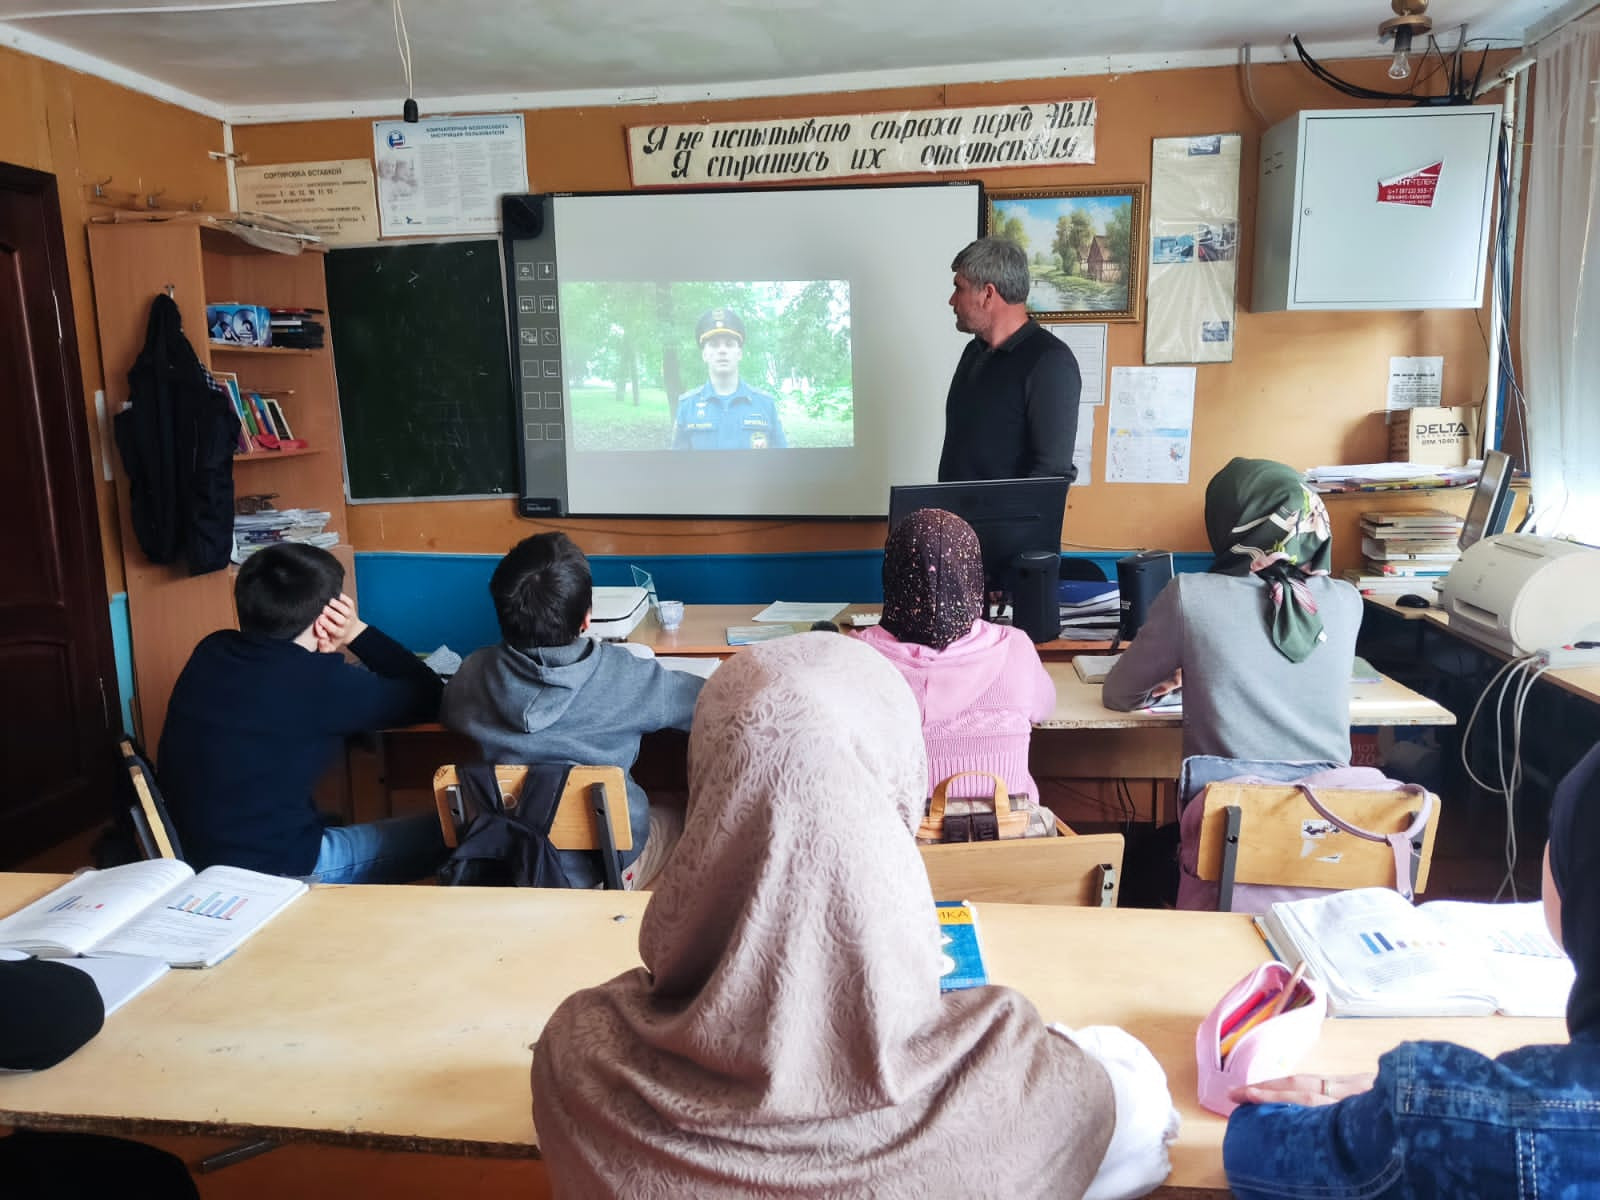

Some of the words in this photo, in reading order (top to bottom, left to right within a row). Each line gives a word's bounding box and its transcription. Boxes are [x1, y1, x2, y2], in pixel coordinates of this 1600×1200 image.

[642, 126, 669, 154] Я
[675, 130, 704, 150] не
[711, 118, 851, 148] испытываю
[870, 115, 963, 143] страха
[972, 105, 1034, 138] перед
[263, 169, 307, 180] СОРТИРОВКА
[307, 167, 342, 177] ВСТАВКОЙ
[670, 150, 692, 178] Я
[707, 150, 830, 181] страшусь
[850, 147, 887, 170] их
[1416, 422, 1469, 436] DELTA
